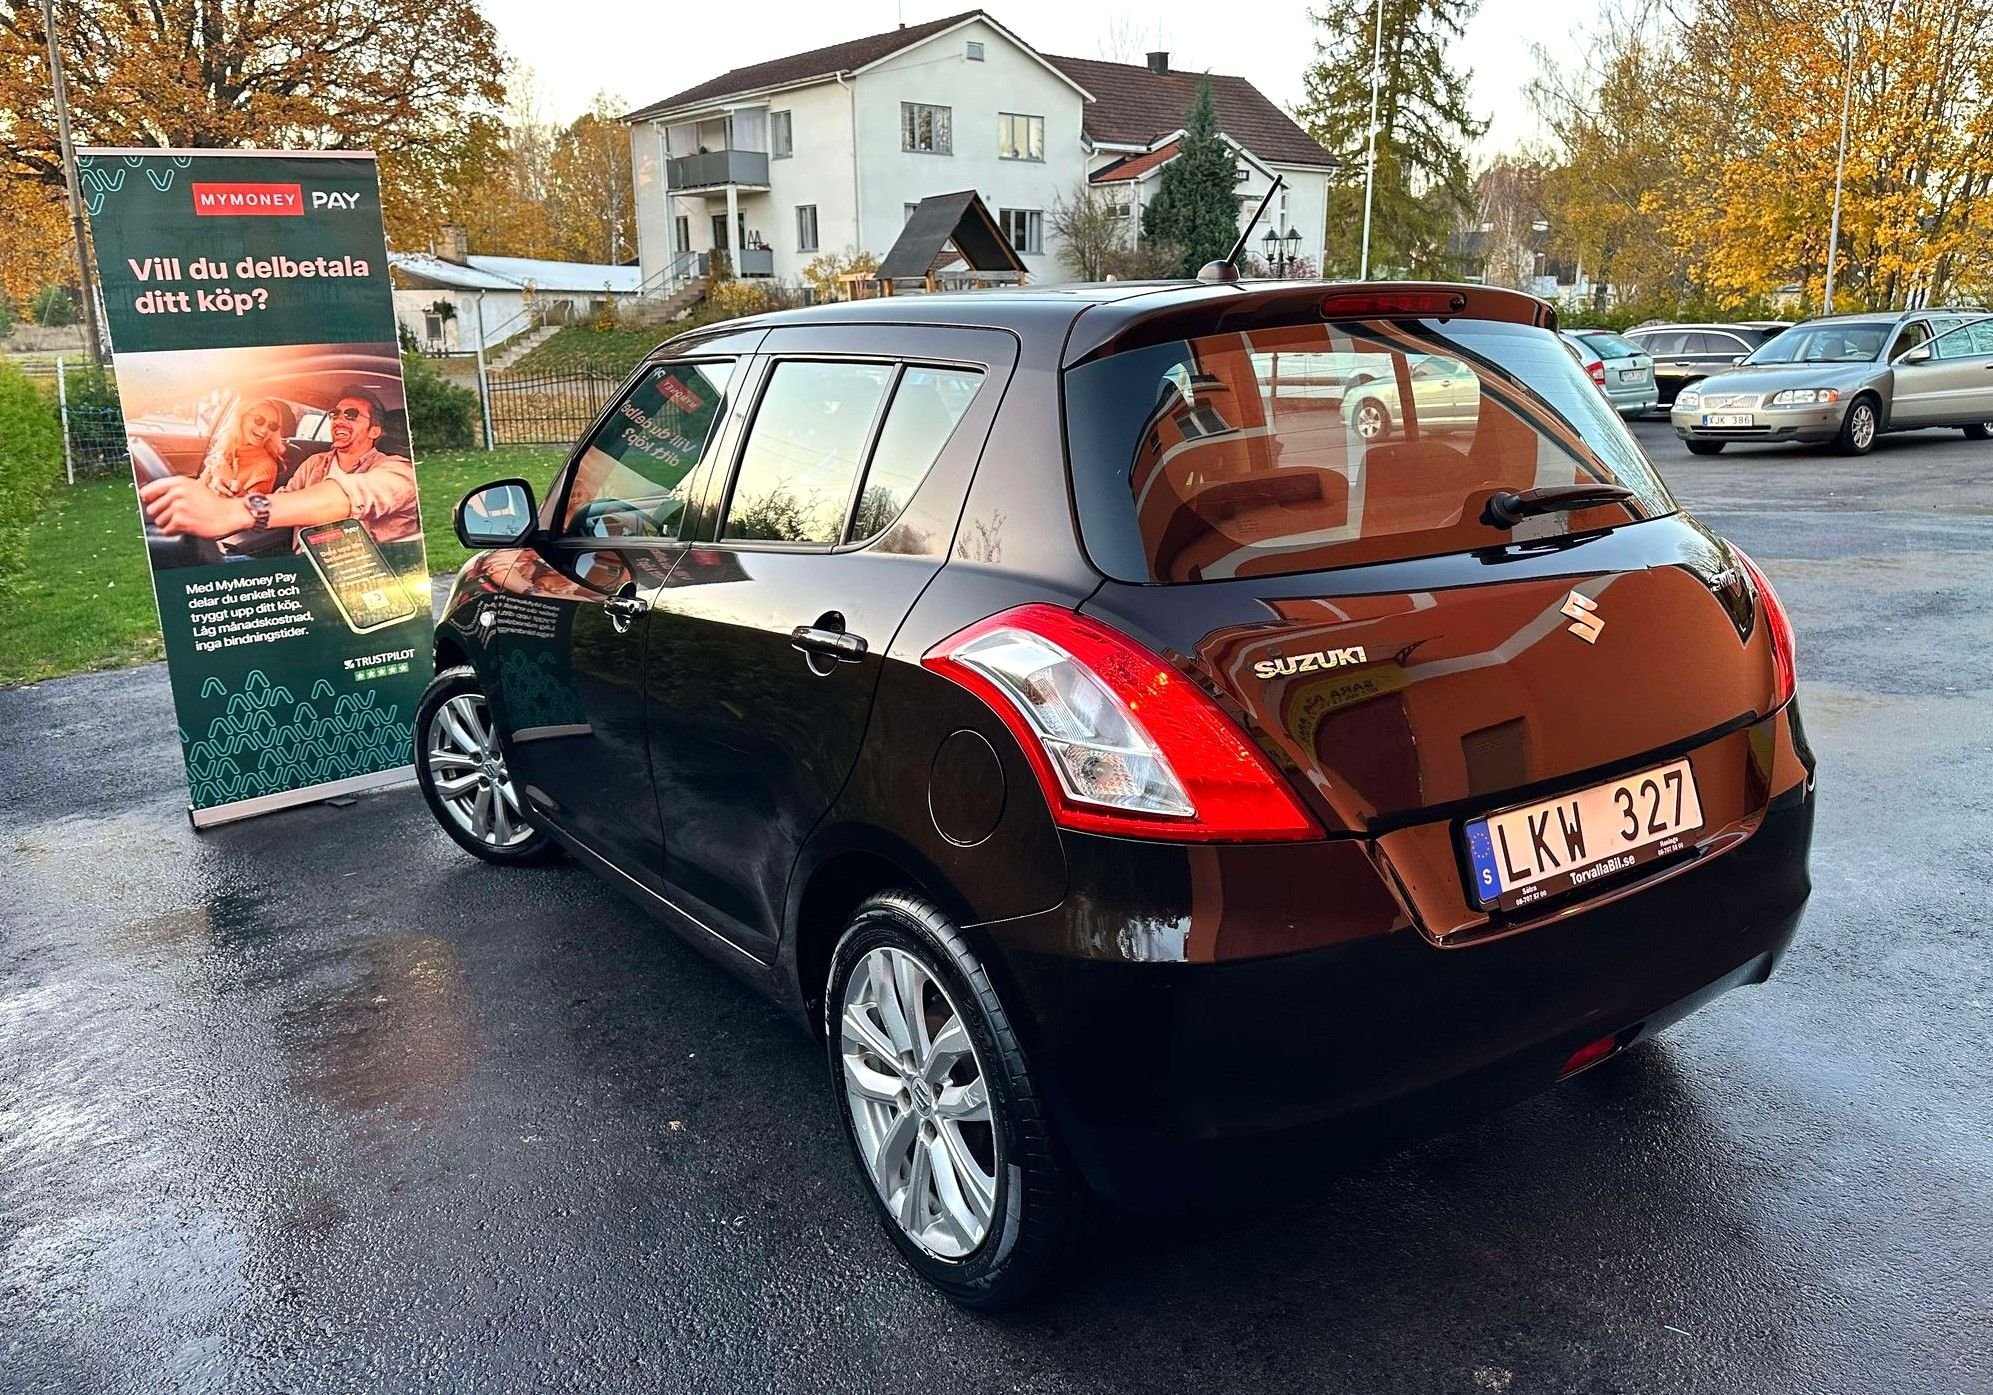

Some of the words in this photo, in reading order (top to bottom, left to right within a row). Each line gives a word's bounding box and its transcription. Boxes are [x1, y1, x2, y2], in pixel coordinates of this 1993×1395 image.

[200, 193, 296, 206] MYMONEY
[311, 191, 361, 210] PAY
[128, 257, 182, 281] Vill
[189, 257, 229, 280] du
[235, 255, 370, 279] delbetala
[135, 290, 192, 314] ditt
[196, 287, 269, 316] köp?
[1709, 416, 1726, 425] XJK
[1731, 416, 1750, 425] 386
[185, 583, 214, 595] Med
[215, 575, 274, 592] MyMoney
[274, 572, 298, 584] Pay
[188, 597, 220, 609] delar
[221, 594, 239, 604] du
[239, 588, 276, 602] enkelt
[277, 585, 300, 596] och
[190, 609, 229, 624] tryggt
[230, 607, 255, 619] upp
[256, 603, 277, 614] ditt
[277, 599, 303, 611] köp.
[192, 626, 217, 638] Låg
[218, 610, 315, 634] månadskostnad,
[195, 639, 223, 652] inga
[224, 626, 310, 648] bindningstider.
[354, 648, 416, 668] TRUSTPILOT
[1253, 645, 1368, 680] SUZUKI
[1497, 801, 1587, 884] LKW
[1614, 769, 1683, 841] 327
[1482, 868, 1493, 885] S
[1570, 854, 1636, 886] TorvallaBil.se
